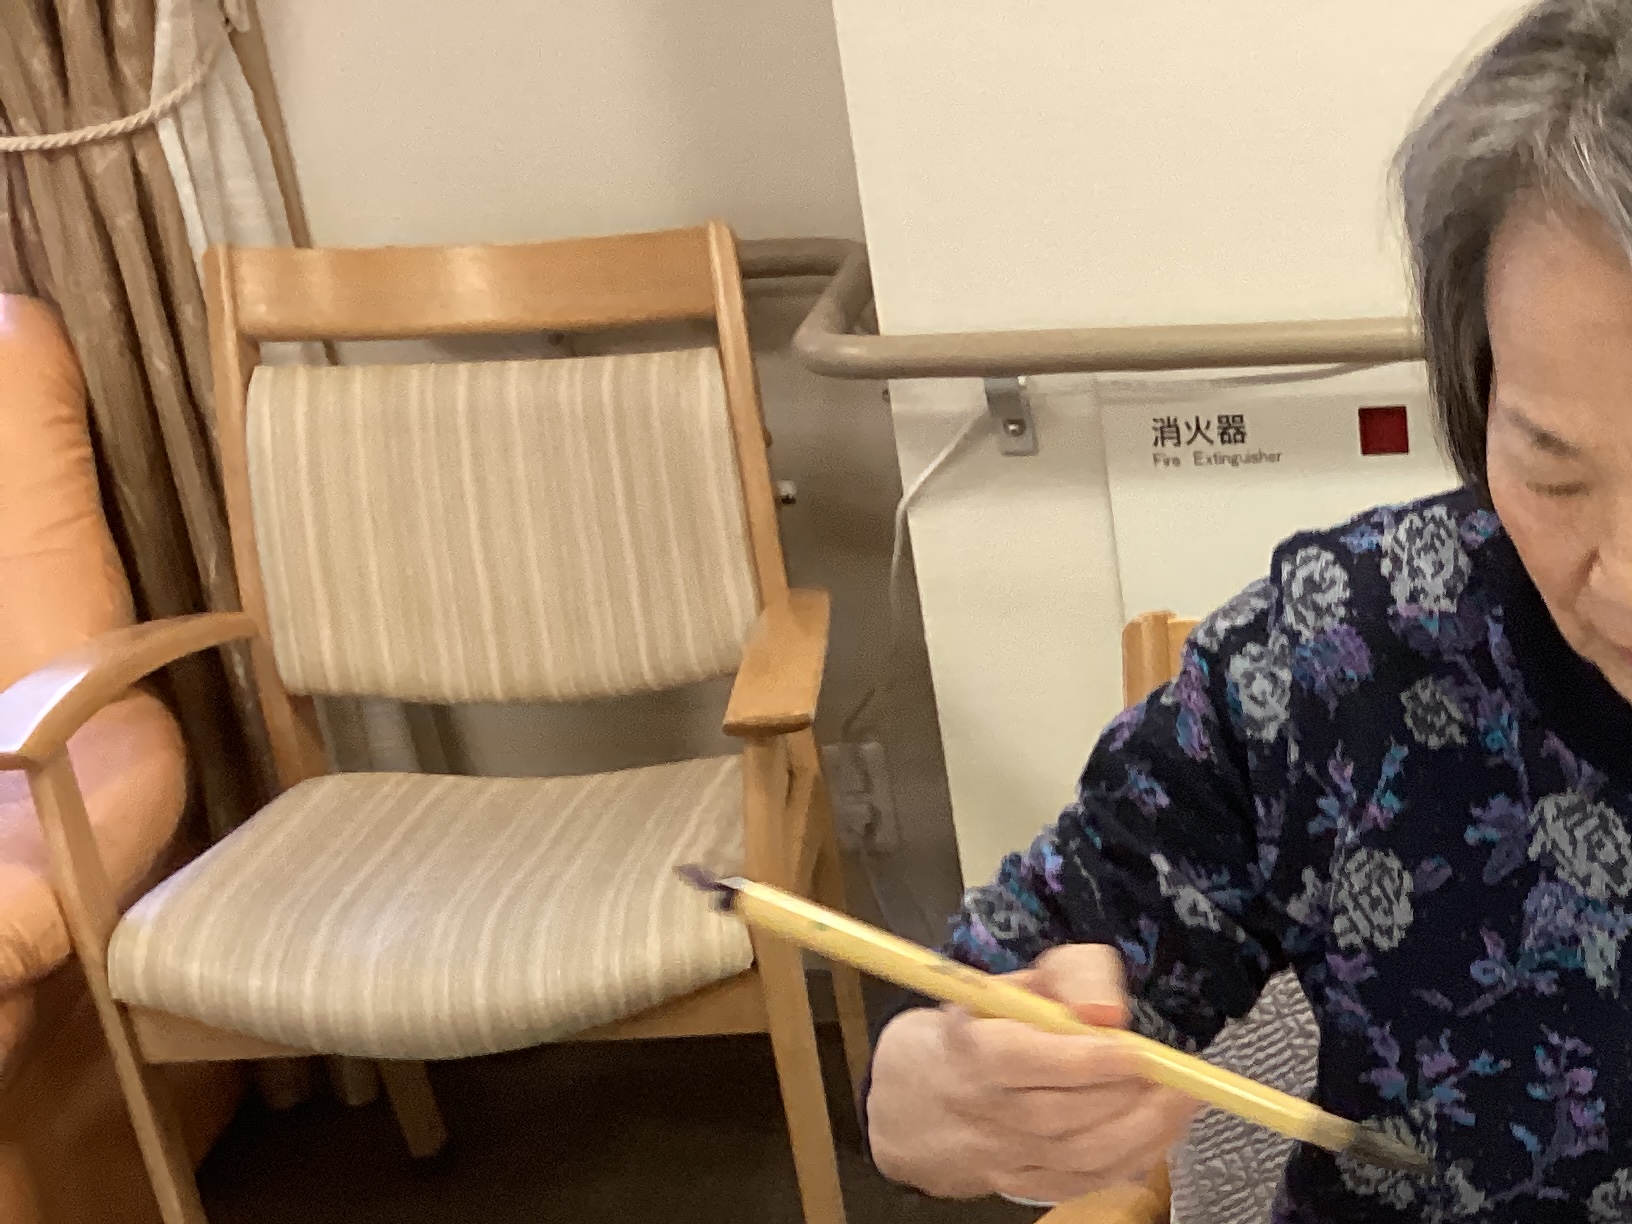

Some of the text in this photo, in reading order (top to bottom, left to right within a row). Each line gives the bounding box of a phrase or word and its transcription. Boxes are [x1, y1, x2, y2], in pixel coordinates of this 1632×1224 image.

[1151, 414, 1247, 447] 消火器
[1152, 449, 1282, 468] Fire Extinguisher
